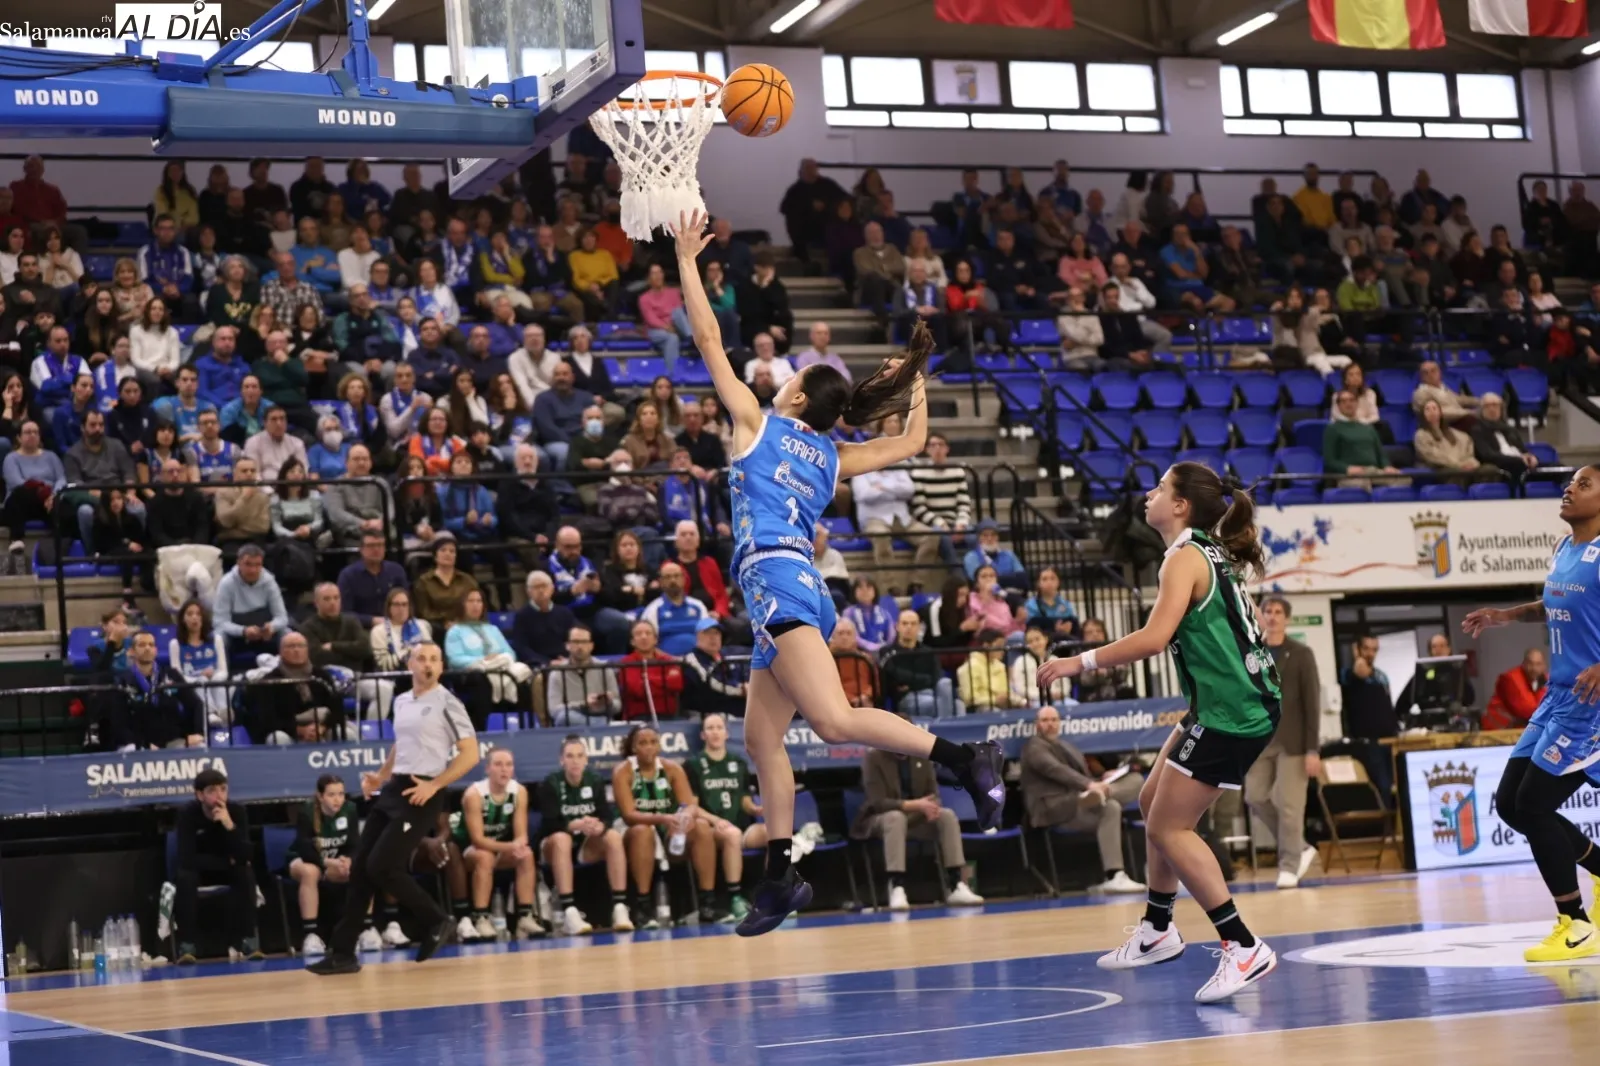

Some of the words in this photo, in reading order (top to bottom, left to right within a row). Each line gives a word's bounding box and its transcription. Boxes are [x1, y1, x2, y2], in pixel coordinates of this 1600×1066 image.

[15, 89, 99, 106] MONDO
[318, 108, 396, 127] MONDO
[780, 435, 827, 469] SORIANO
[1458, 530, 1556, 554] Ayuntamiento
[1460, 555, 1478, 574] de
[1482, 554, 1551, 573] Salamanc
[1551, 628, 1562, 655] 11
[720, 791, 732, 809] 9
[1491, 823, 1515, 847] de
